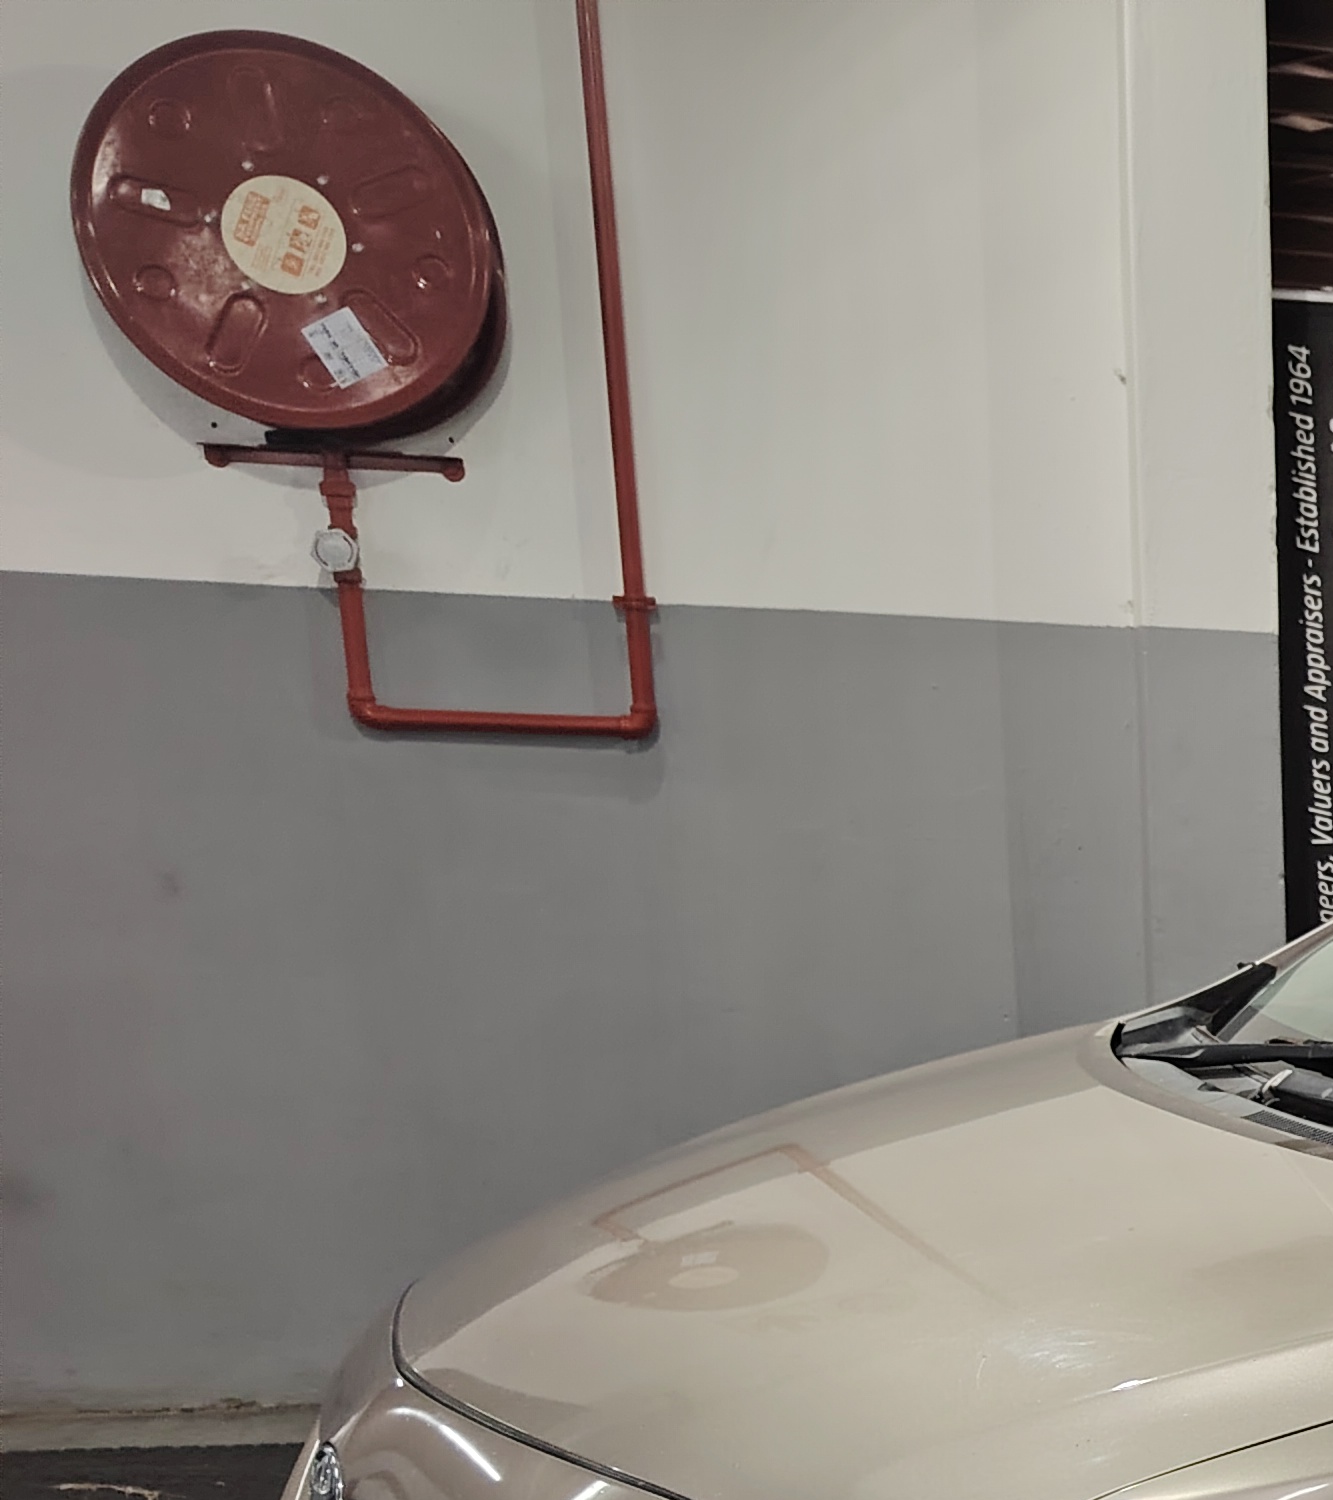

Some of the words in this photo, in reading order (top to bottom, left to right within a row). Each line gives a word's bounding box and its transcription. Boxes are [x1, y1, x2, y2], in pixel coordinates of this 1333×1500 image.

[1287, 343, 1314, 405] 1964
[1287, 411, 1320, 554] Established
[1299, 573, 1331, 703] Appraisers
[1302, 704, 1330, 754] and
[1307, 758, 1333, 846] Valuers
